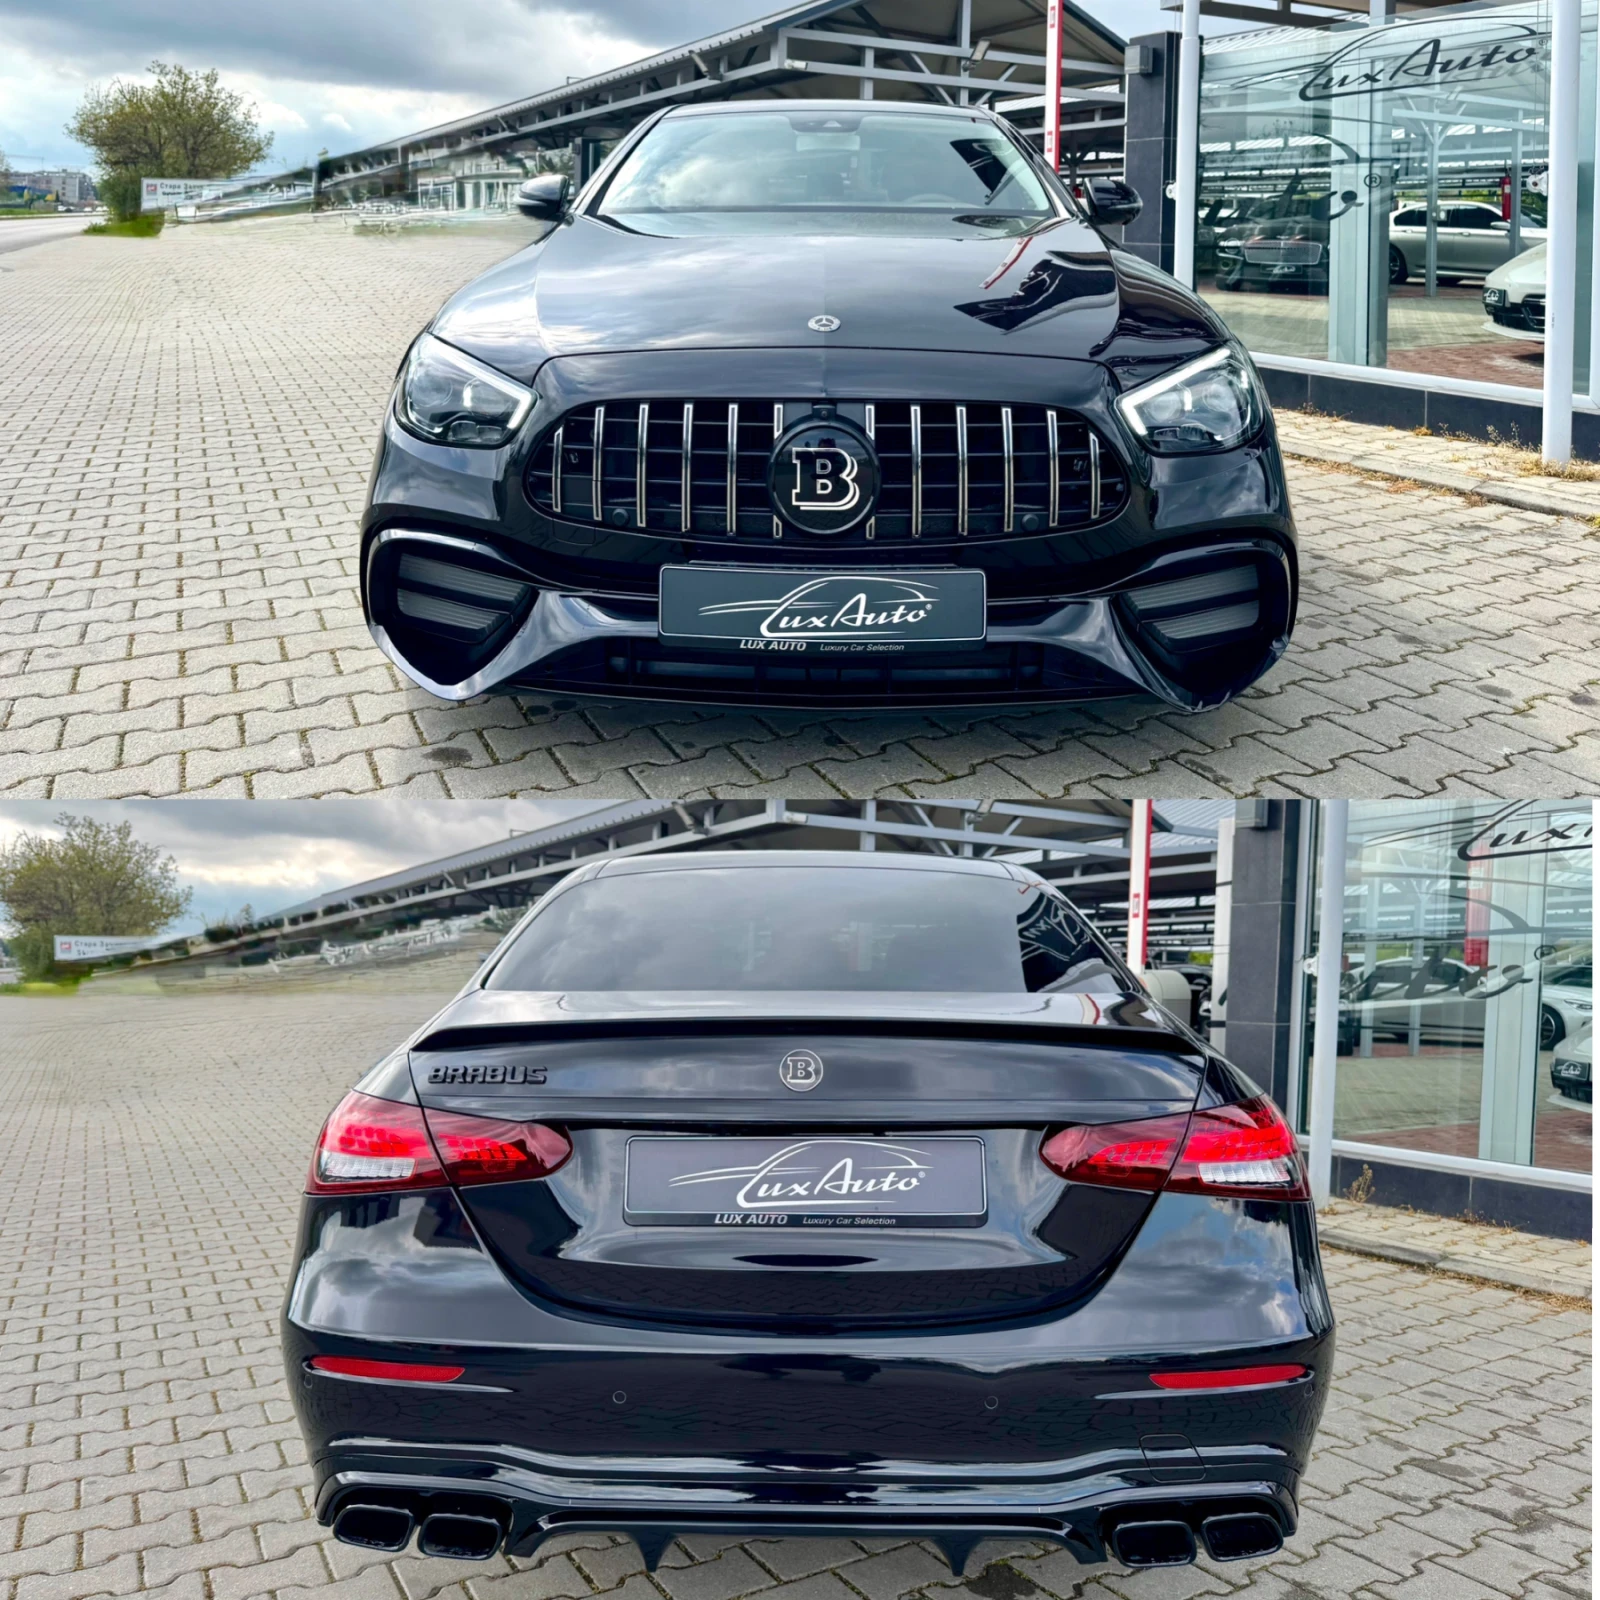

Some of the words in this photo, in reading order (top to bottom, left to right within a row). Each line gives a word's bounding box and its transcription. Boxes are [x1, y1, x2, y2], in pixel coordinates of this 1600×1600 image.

[739, 639, 767, 650] LUX
[768, 640, 807, 652] AUTO
[819, 643, 849, 652] Luxury
[850, 643, 865, 651] Car
[866, 643, 905, 652] Selection
[427, 1065, 548, 1085] BRABUS
[787, 1056, 816, 1083] B
[714, 1213, 744, 1225] LUX
[745, 1213, 788, 1225] AUTO
[802, 1216, 835, 1226] Luxury
[836, 1216, 853, 1225] Car
[854, 1216, 897, 1226] Selection
